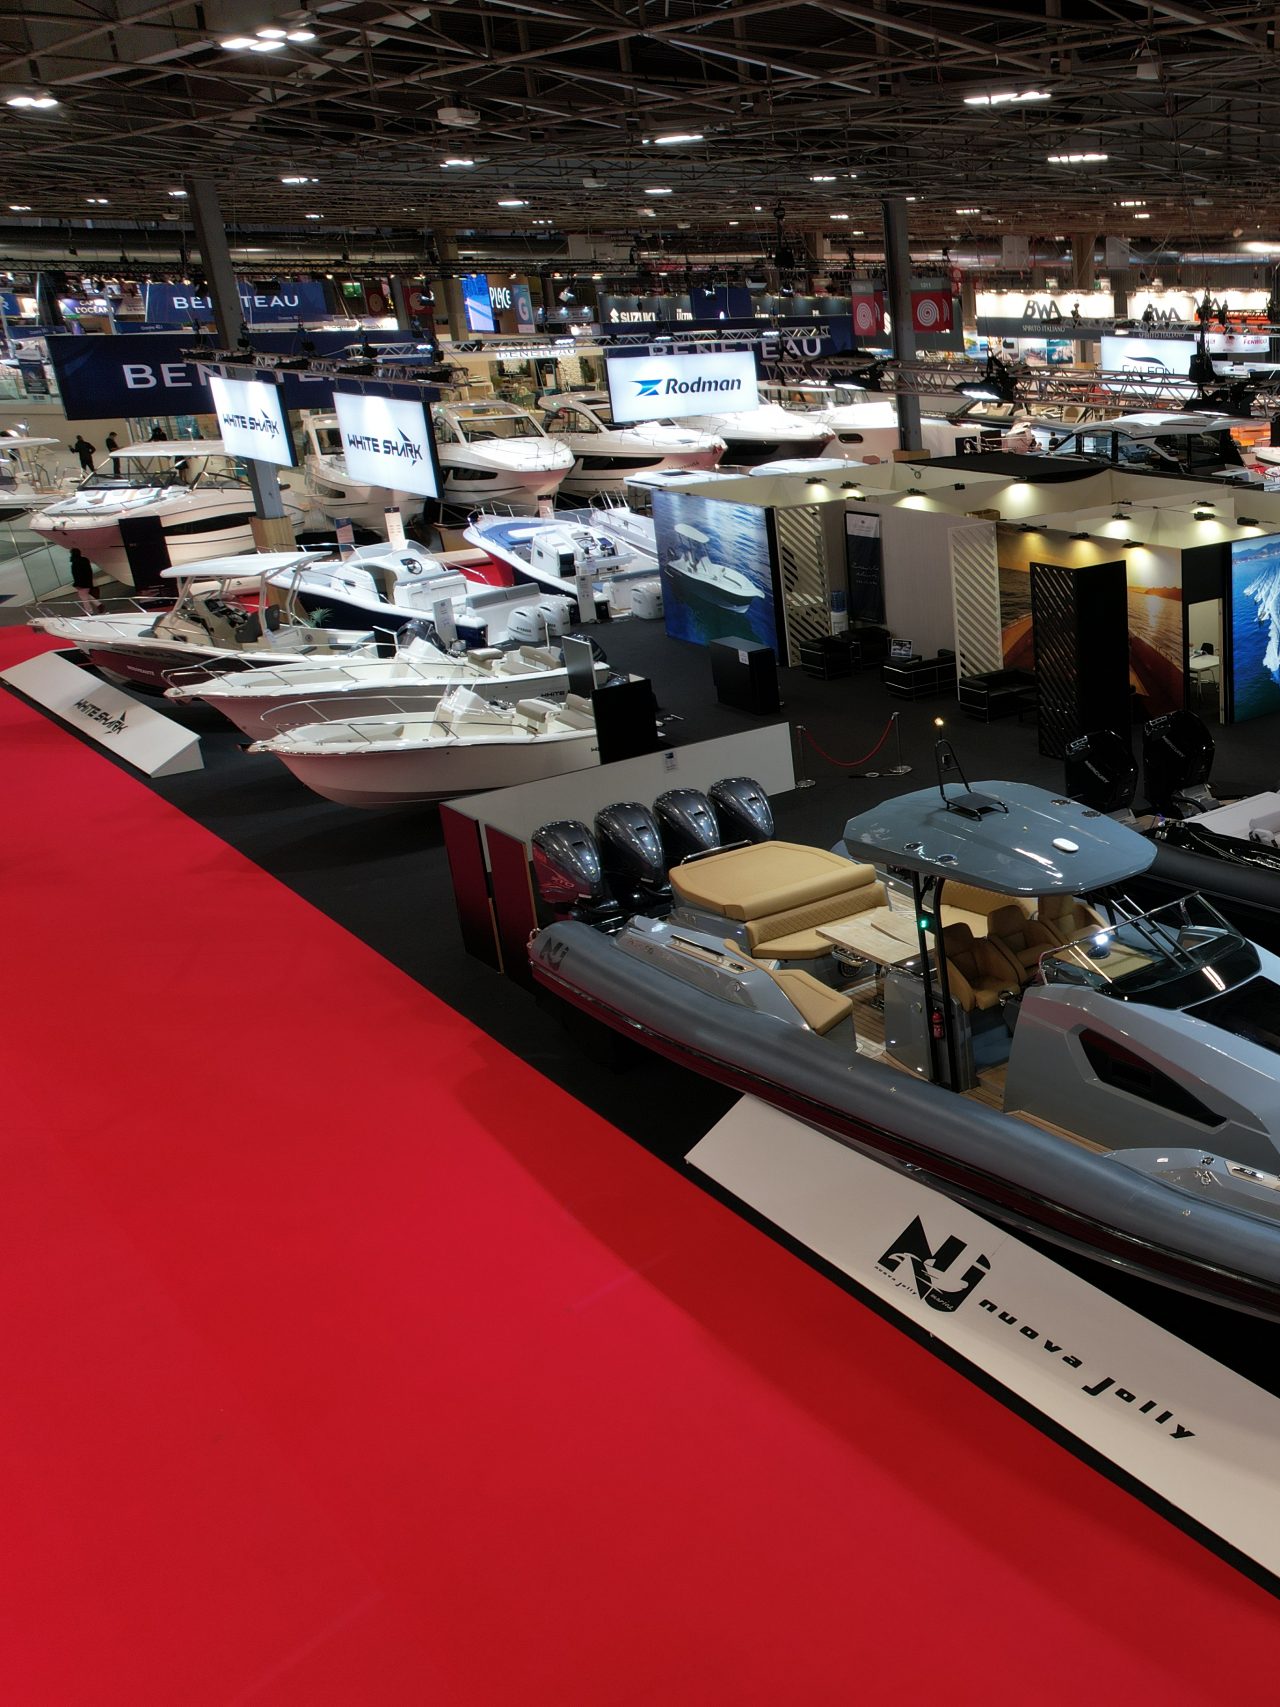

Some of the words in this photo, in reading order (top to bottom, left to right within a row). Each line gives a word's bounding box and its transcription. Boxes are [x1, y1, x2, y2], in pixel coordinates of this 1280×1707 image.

[173, 295, 299, 309] BETEAU
[620, 312, 656, 322] SUZUKI
[665, 376, 742, 395] Rodman
[223, 413, 248, 429] WHITE
[249, 411, 280, 437] SHARK
[347, 434, 380, 451] WHITE
[383, 429, 423, 464] SHARK
[73, 698, 99, 721] WHITE
[94, 710, 129, 735] SHARK
[978, 1298, 1083, 1368] nuova
